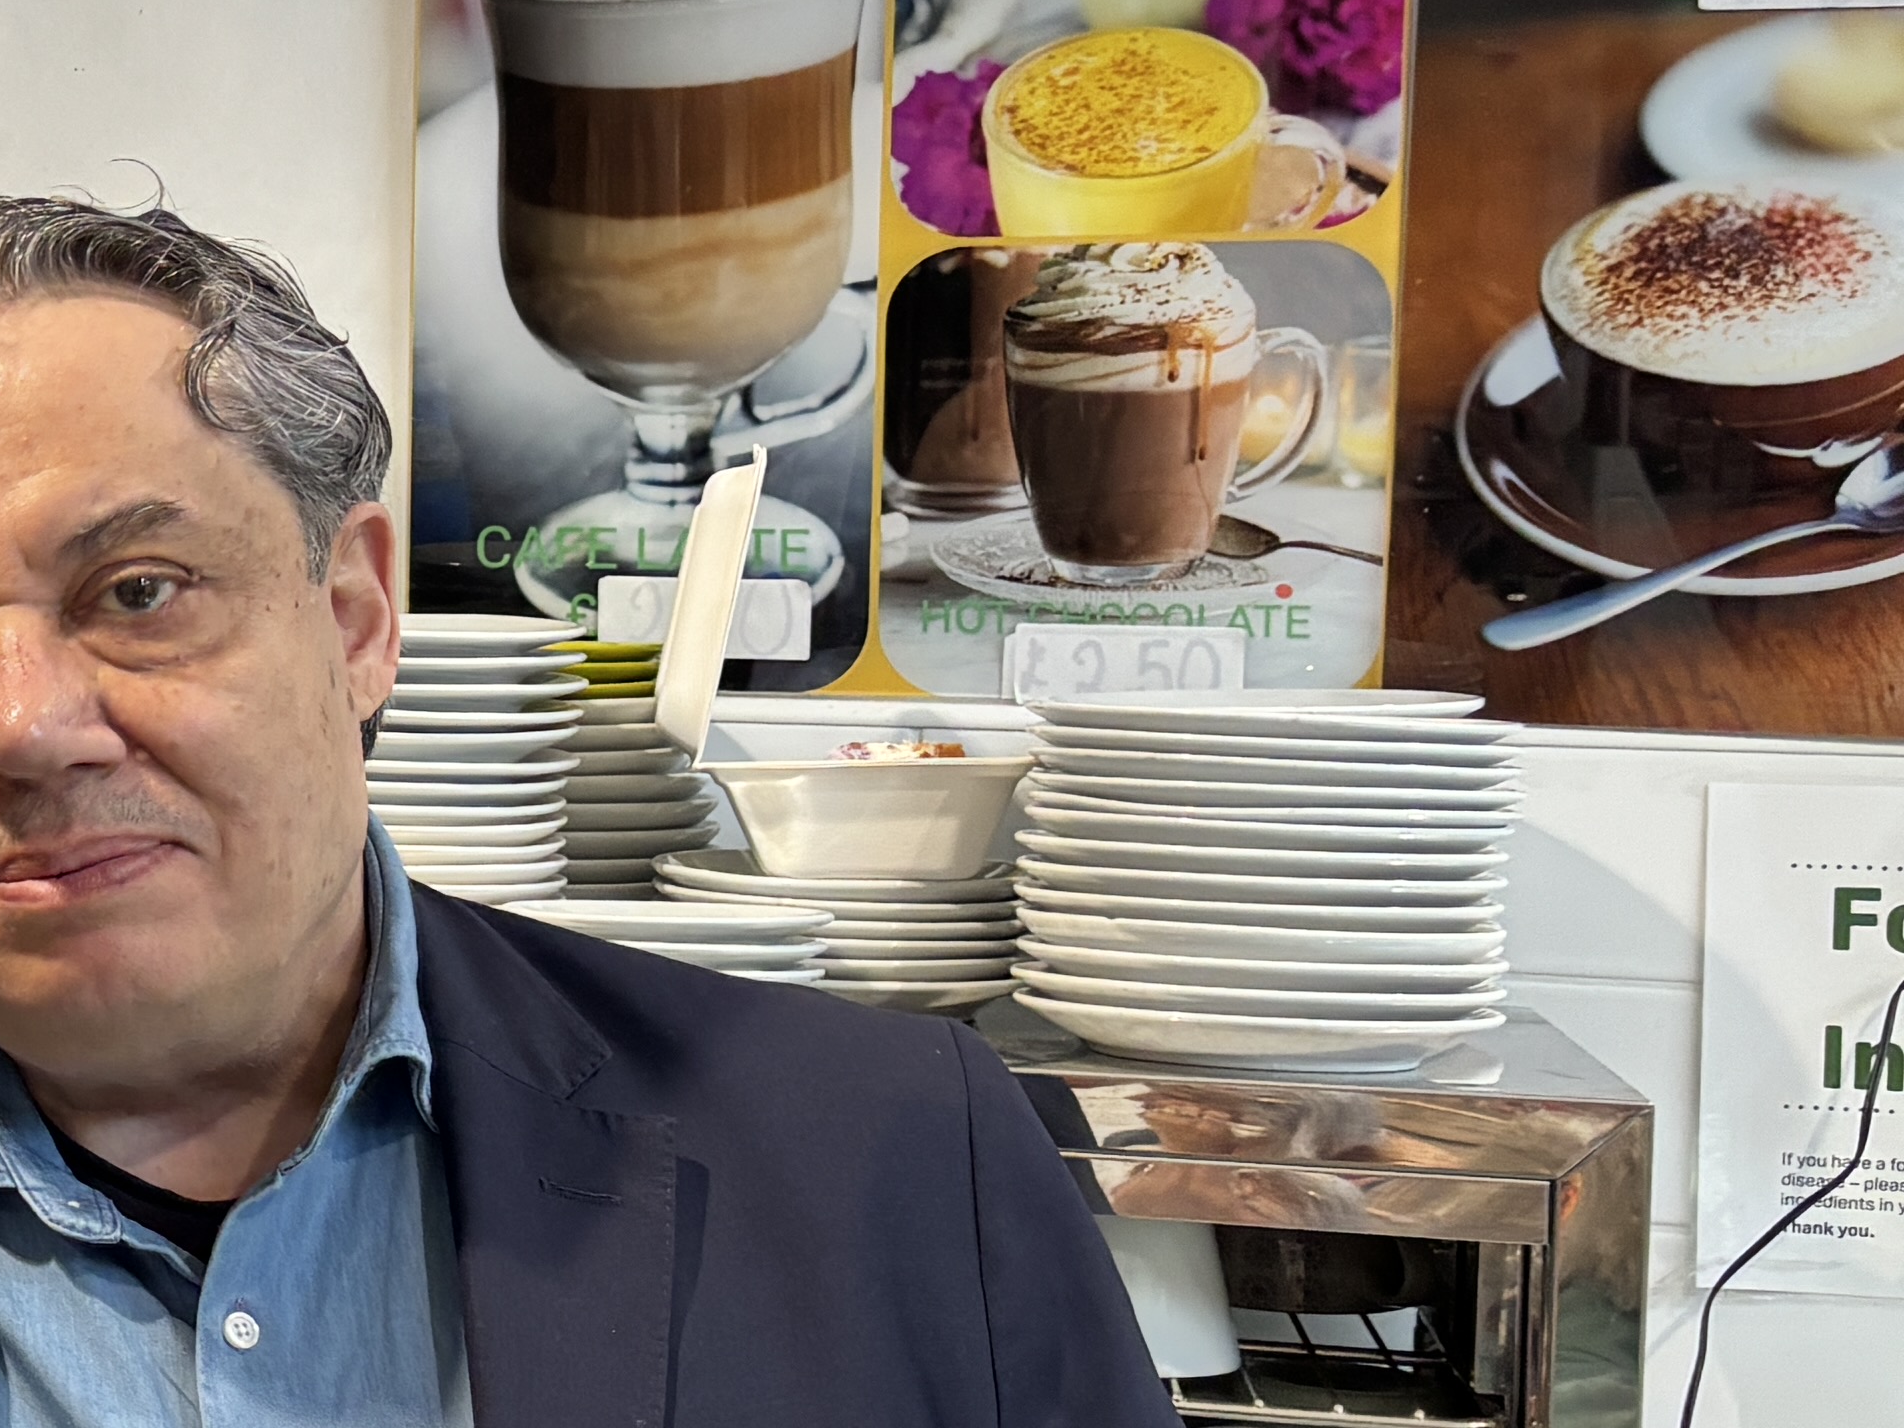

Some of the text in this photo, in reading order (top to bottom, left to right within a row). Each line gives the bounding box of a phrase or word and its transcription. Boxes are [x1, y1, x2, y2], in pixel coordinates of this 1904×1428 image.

[477, 526, 811, 572] CAFE LTE
[920, 599, 1017, 635] HOT
[1782, 1152, 1794, 1166] If
[1797, 1155, 1827, 1169] you
[1831, 1154, 1872, 1170] hae
[1876, 1159, 1886, 1171] a
[1781, 1172, 1845, 1188] disea
[1780, 1192, 1876, 1211] inedients
[1879, 1197, 1894, 1212] in
[1783, 1219, 1875, 1239] hank you.
